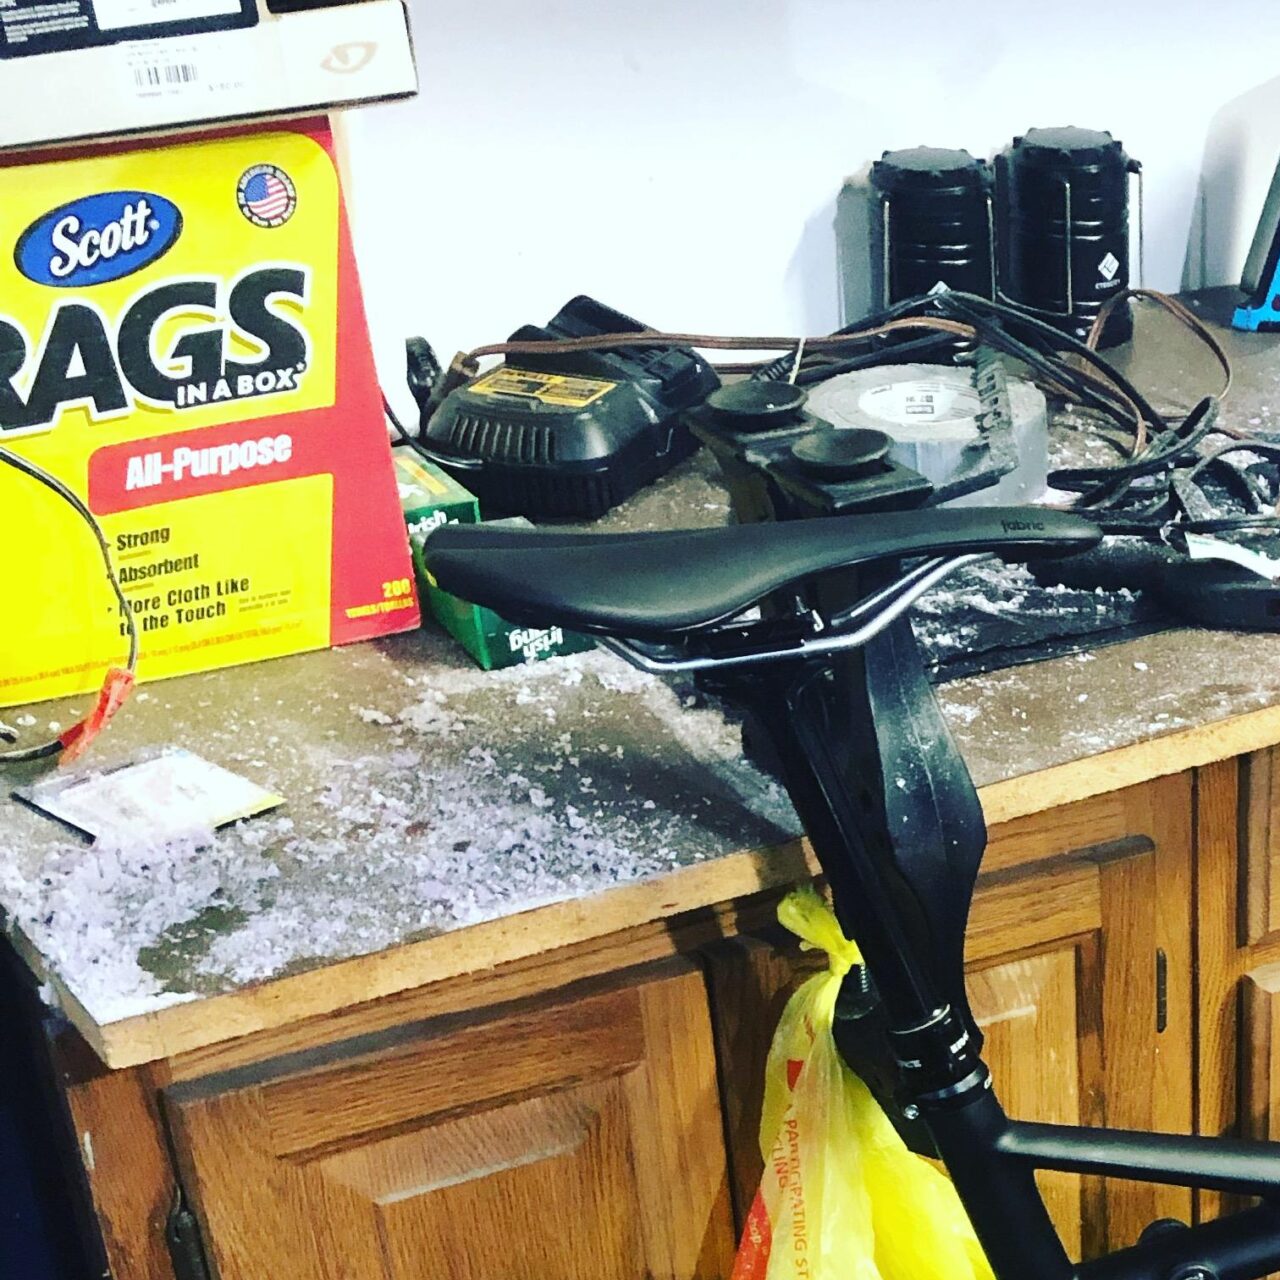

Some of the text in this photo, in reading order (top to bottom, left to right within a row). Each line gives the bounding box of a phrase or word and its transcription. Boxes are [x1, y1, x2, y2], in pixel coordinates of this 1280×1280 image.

[49, 200, 151, 277] Scott
[177, 382, 207, 405] IN
[213, 377, 232, 399] A
[125, 434, 292, 490] All-Purpose
[117, 528, 170, 551] Strong
[1001, 520, 1044, 533] fabric
[119, 553, 199, 584] Absorbent
[119, 594, 161, 618] More
[167, 584, 210, 606] Cloth
[217, 578, 249, 597] Like
[382, 578, 411, 598] 200
[143, 613, 169, 631] the
[176, 601, 226, 624] Touch
